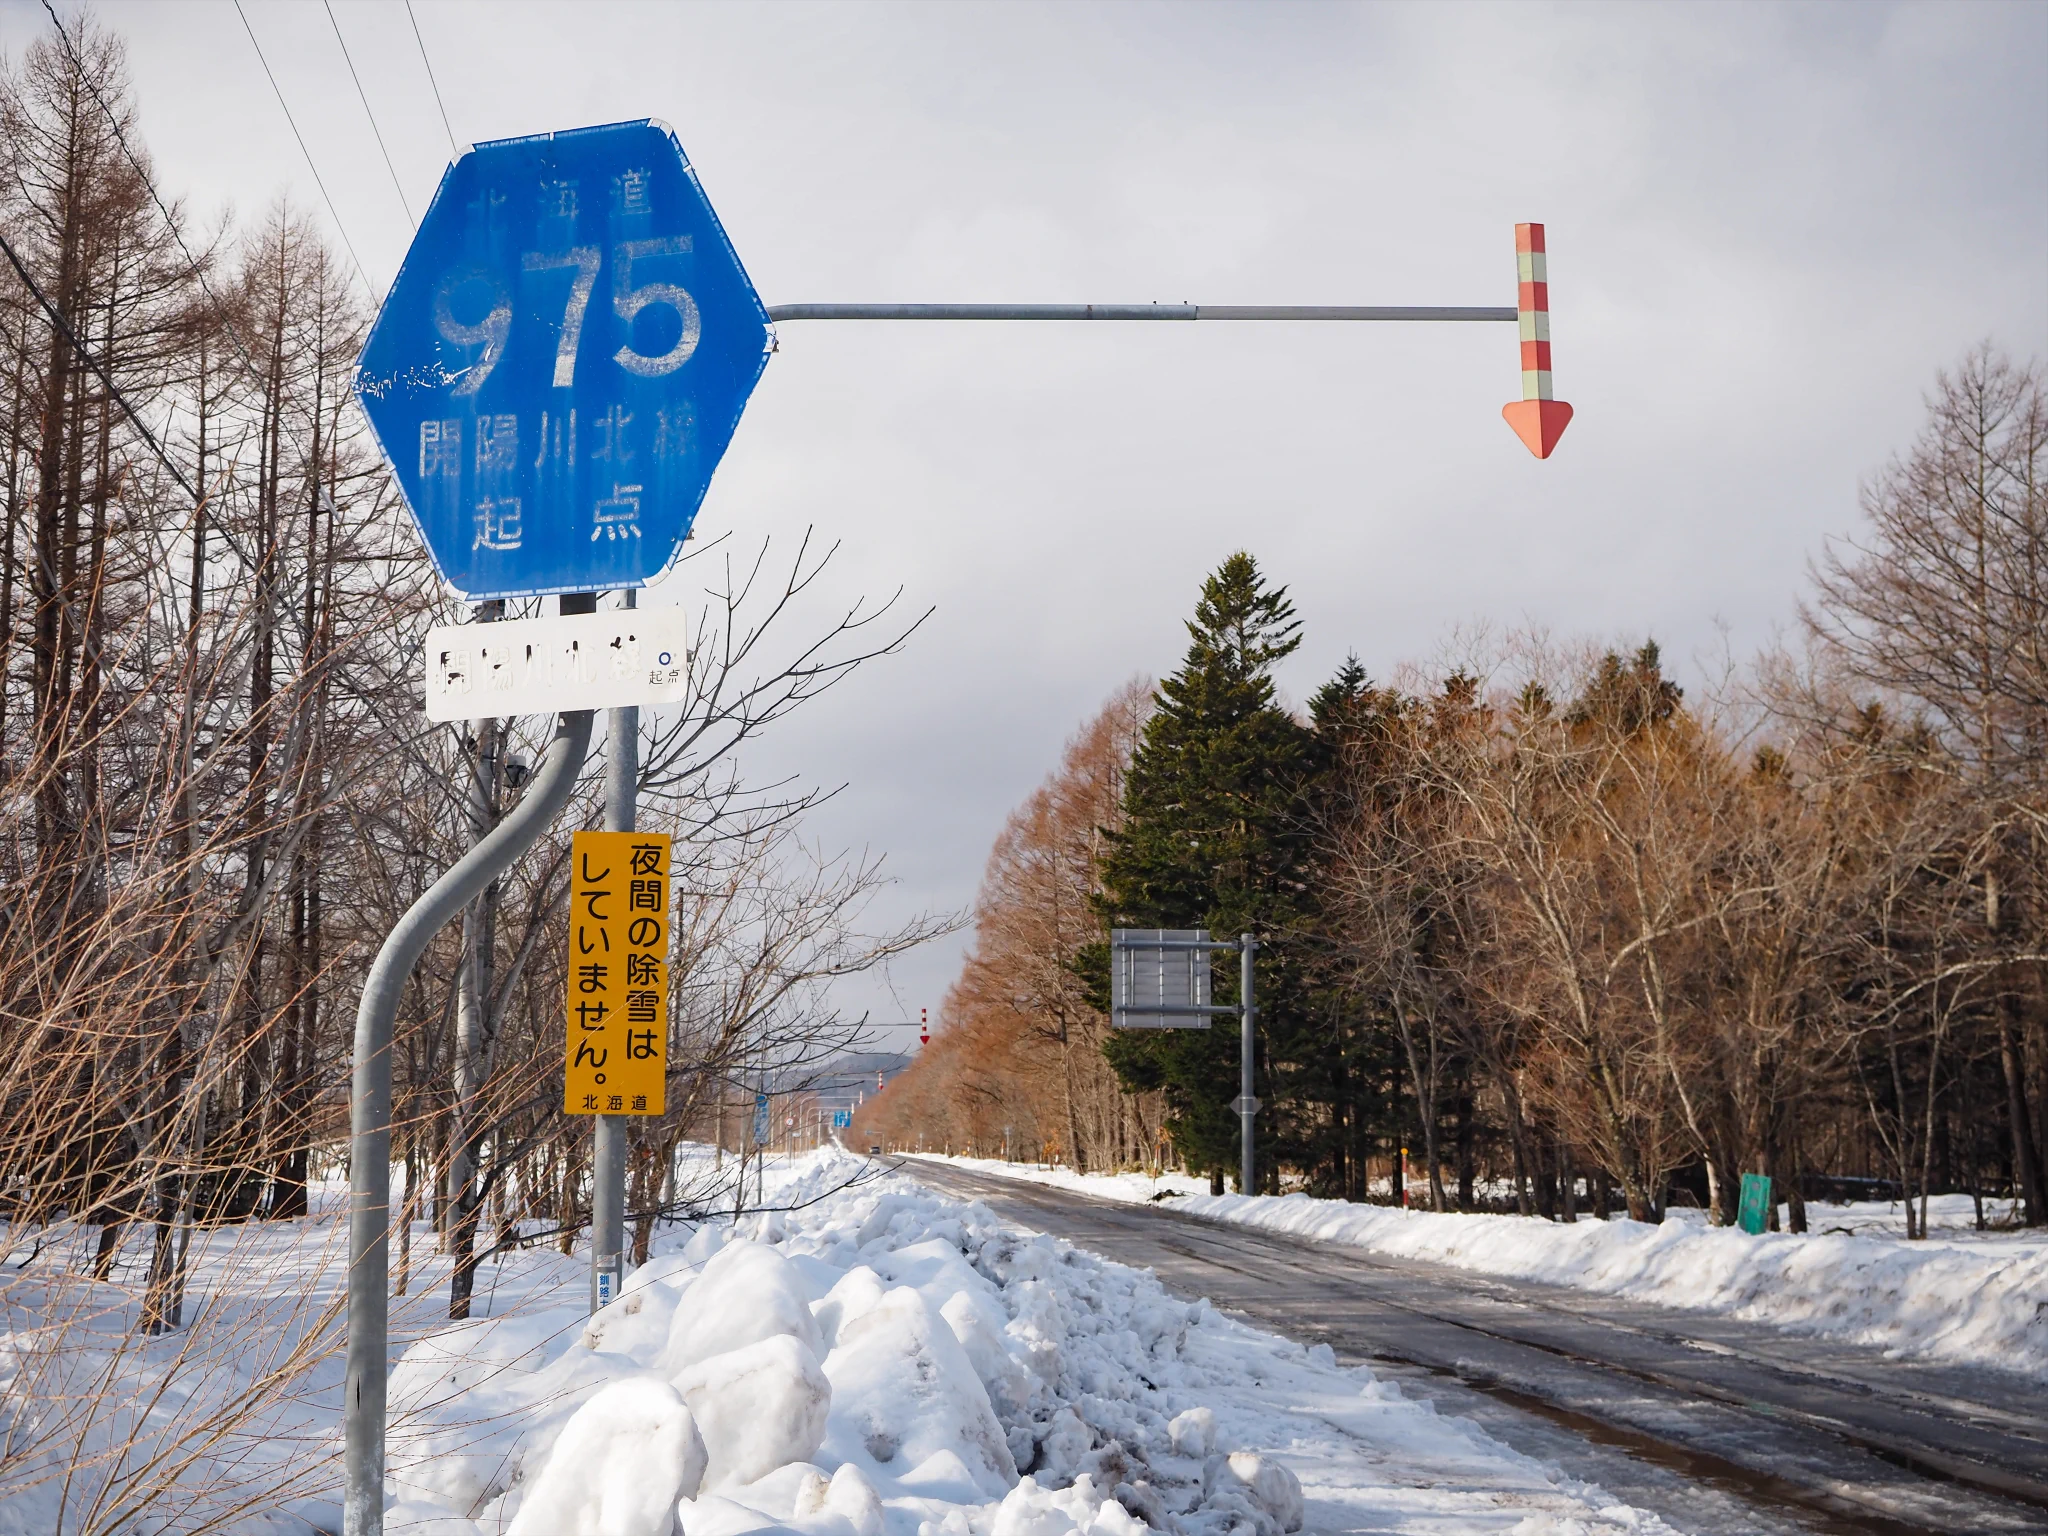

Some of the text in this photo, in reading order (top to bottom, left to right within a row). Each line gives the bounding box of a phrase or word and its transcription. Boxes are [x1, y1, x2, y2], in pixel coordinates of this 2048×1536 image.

[432, 234, 701, 397] 975
[472, 482, 644, 551] 起点
[649, 669, 681, 685] 起点
[574, 852, 612, 1085] していません。
[626, 843, 663, 1060] 夜間の除雪は
[582, 1094, 648, 1111] 北海道
